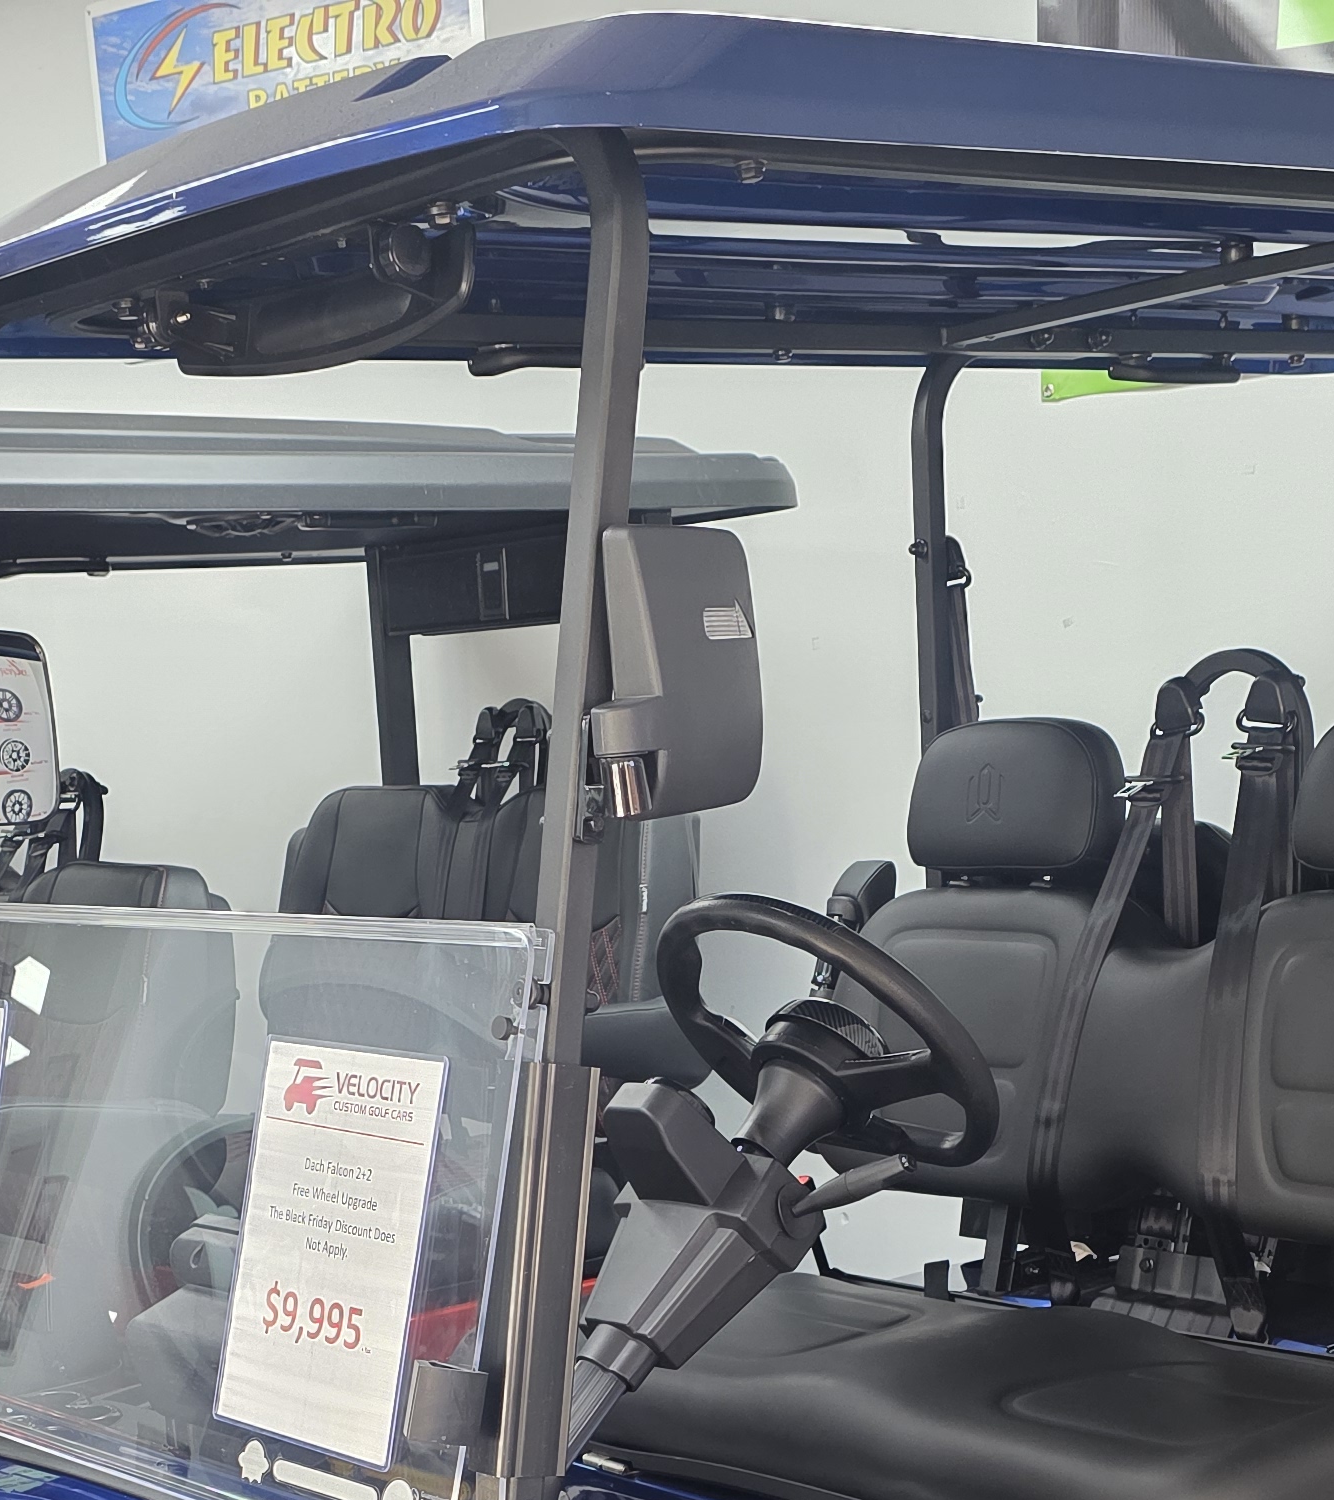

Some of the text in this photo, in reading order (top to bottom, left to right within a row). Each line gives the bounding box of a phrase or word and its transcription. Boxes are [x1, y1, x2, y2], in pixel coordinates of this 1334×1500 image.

[212, 0, 442, 84] ELECTRO
[336, 1071, 421, 1105] VELOCITY
[333, 1100, 414, 1122] CUSTOM GOLF CARS
[304, 1157, 373, 1182] Dach Falcon 2+2
[292, 1182, 378, 1212] Free Wheel Upgrade
[269, 1205, 396, 1244] The Black Friday Discount Does
[305, 1236, 348, 1261] Not Apply.
[262, 1280, 364, 1350] $9,995
